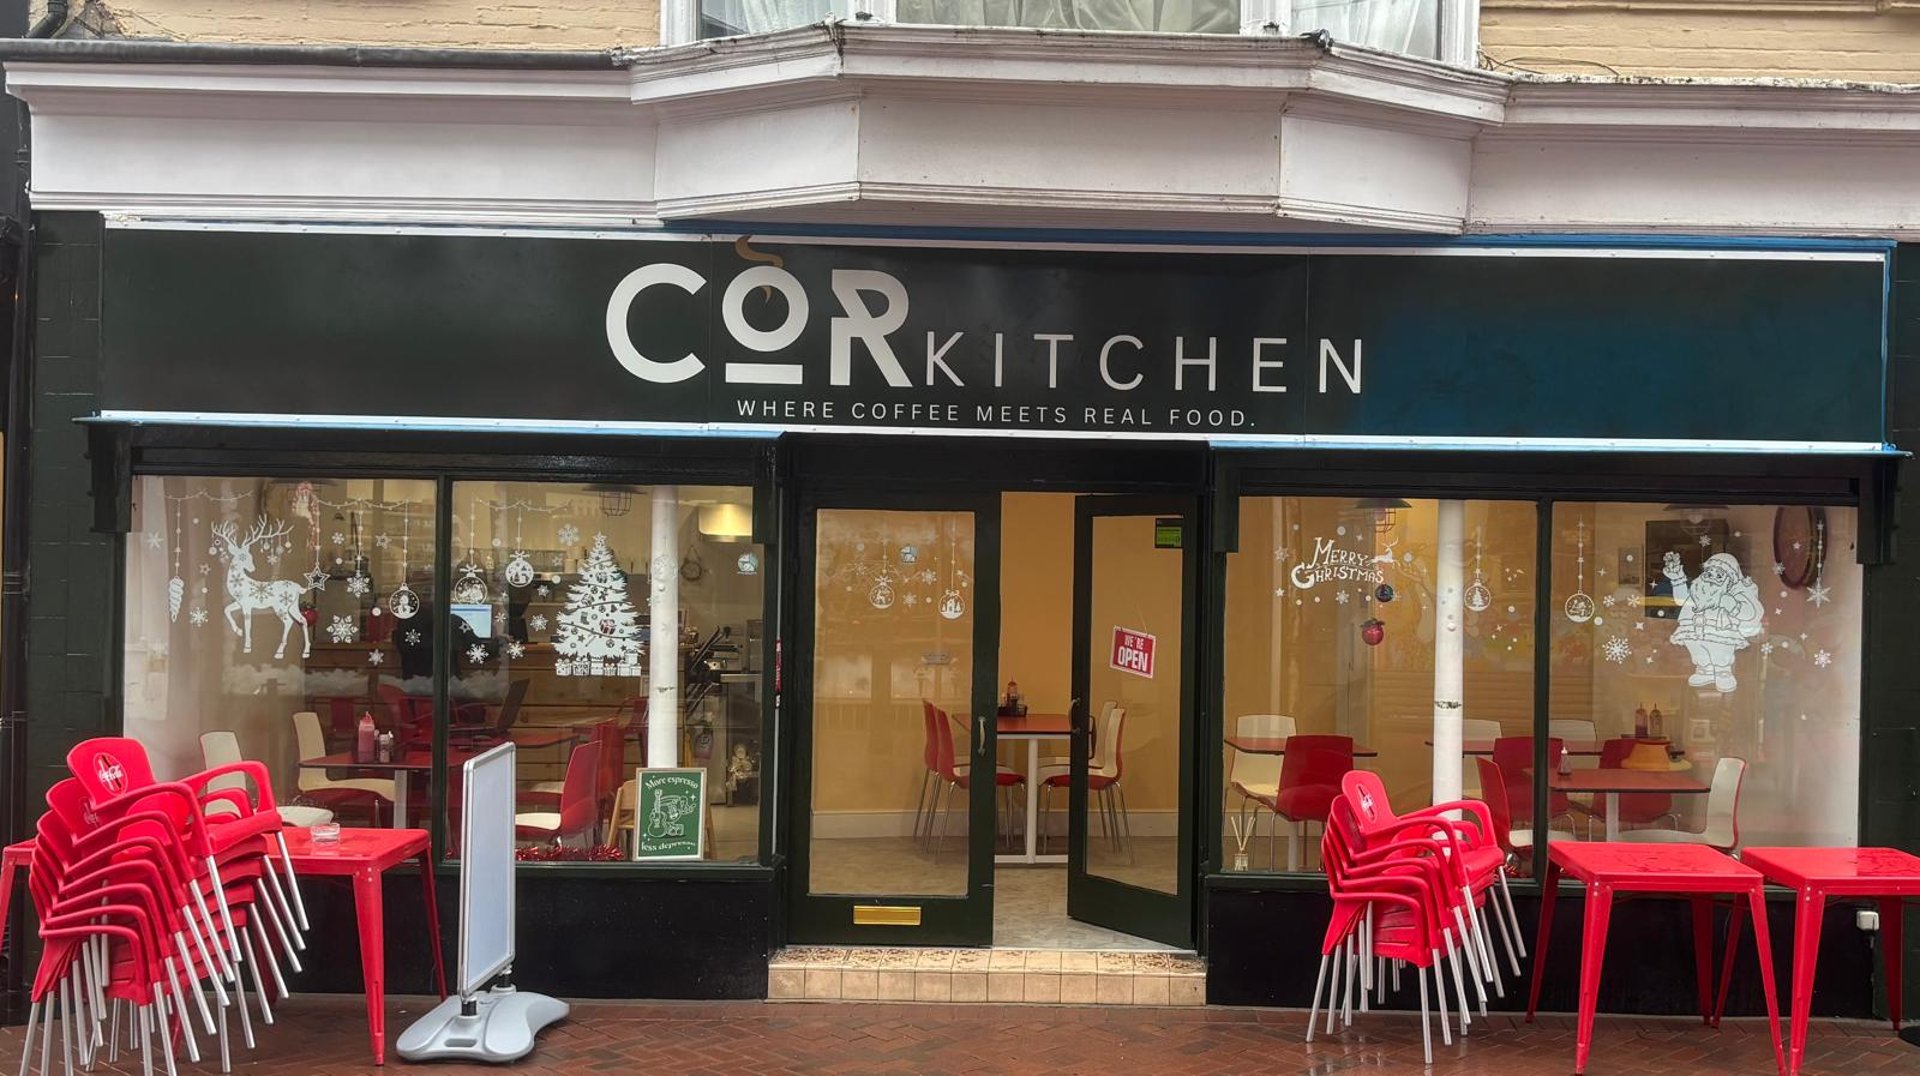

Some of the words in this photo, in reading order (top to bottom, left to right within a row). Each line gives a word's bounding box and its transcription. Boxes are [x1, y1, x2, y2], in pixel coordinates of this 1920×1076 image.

[927, 332, 1361, 393] KITCHEN
[737, 400, 833, 418] WHERE
[852, 402, 957, 421] COFFEE
[977, 406, 1065, 424] MEETS
[1085, 407, 1151, 425] REAL
[1170, 409, 1255, 427] FOOD.
[1124, 634, 1144, 650] WE'RE
[1117, 646, 1148, 672] OPEN
[645, 777, 666, 789] More
[667, 776, 699, 789] espresso
[641, 842, 657, 851] less
